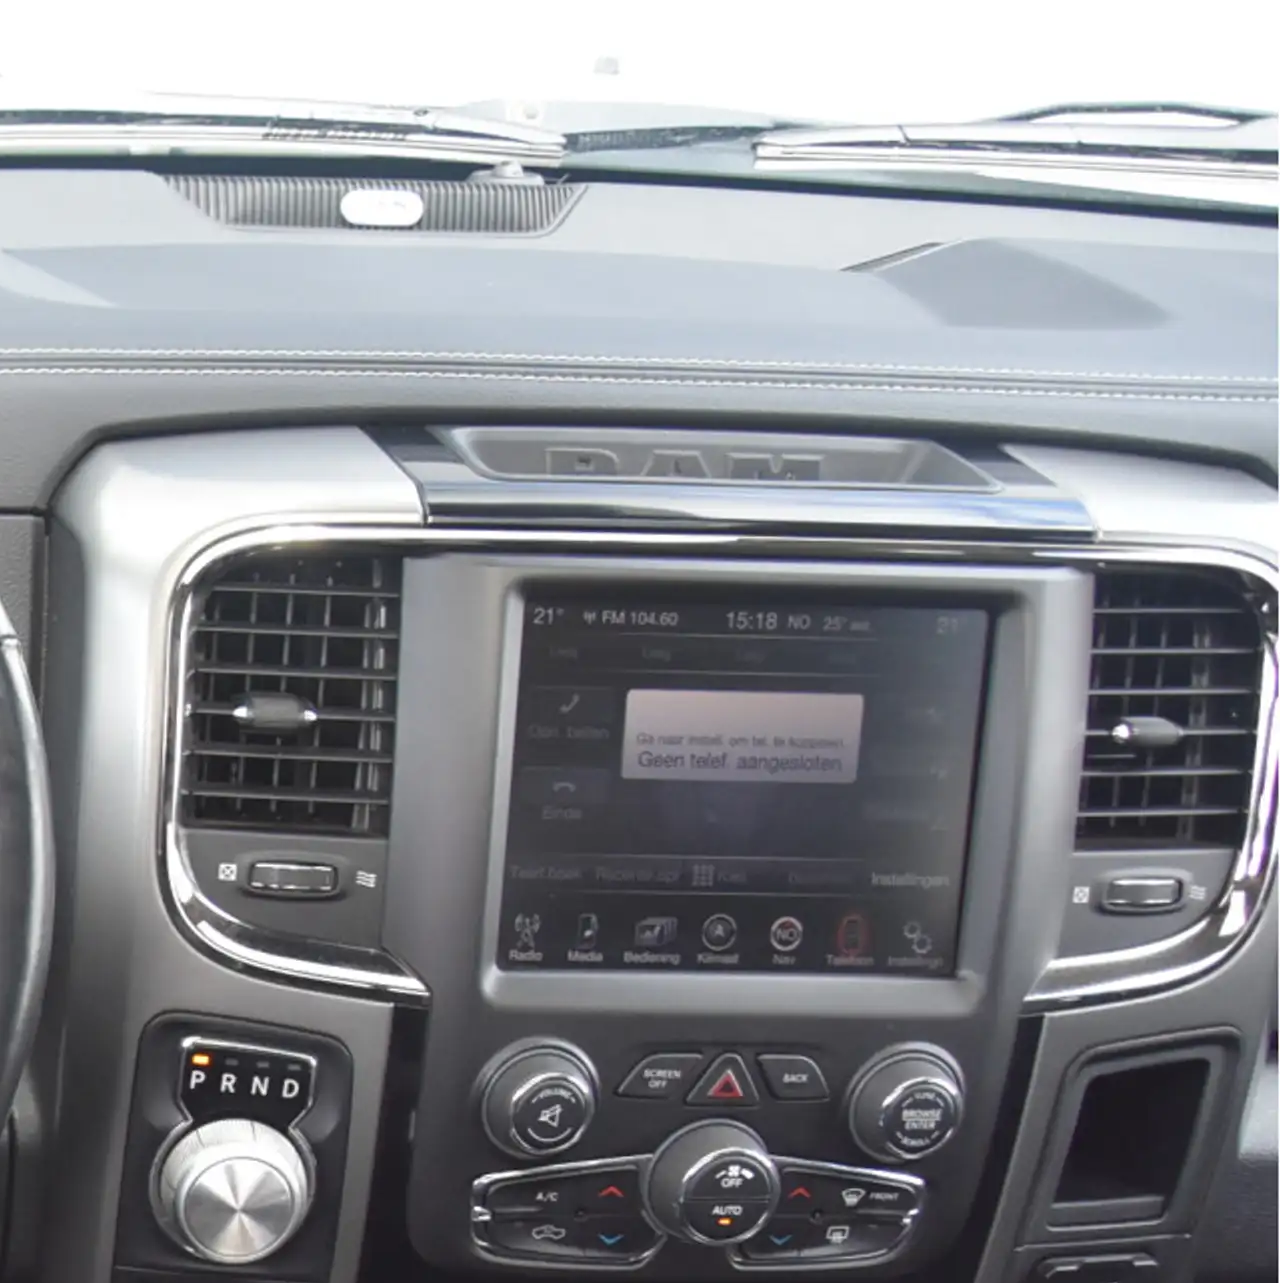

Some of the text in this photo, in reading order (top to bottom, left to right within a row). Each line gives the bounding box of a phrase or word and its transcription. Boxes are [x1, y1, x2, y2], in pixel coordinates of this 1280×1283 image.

[601, 610, 626, 625] FM
[726, 611, 778, 631] 15:18
[787, 614, 811, 630] NO
[637, 750, 685, 769] Geen
[736, 752, 844, 775] aangesloten
[871, 872, 950, 890] Instellingen
[643, 1068, 682, 1080] SCREEN
[782, 1073, 809, 1084] BACK
[190, 1070, 300, 1099] P R N D
[648, 1080, 668, 1089] OFF
[720, 1177, 743, 1188] OFF
[535, 1191, 559, 1202] A/C
[712, 1204, 743, 1216] AUTO
